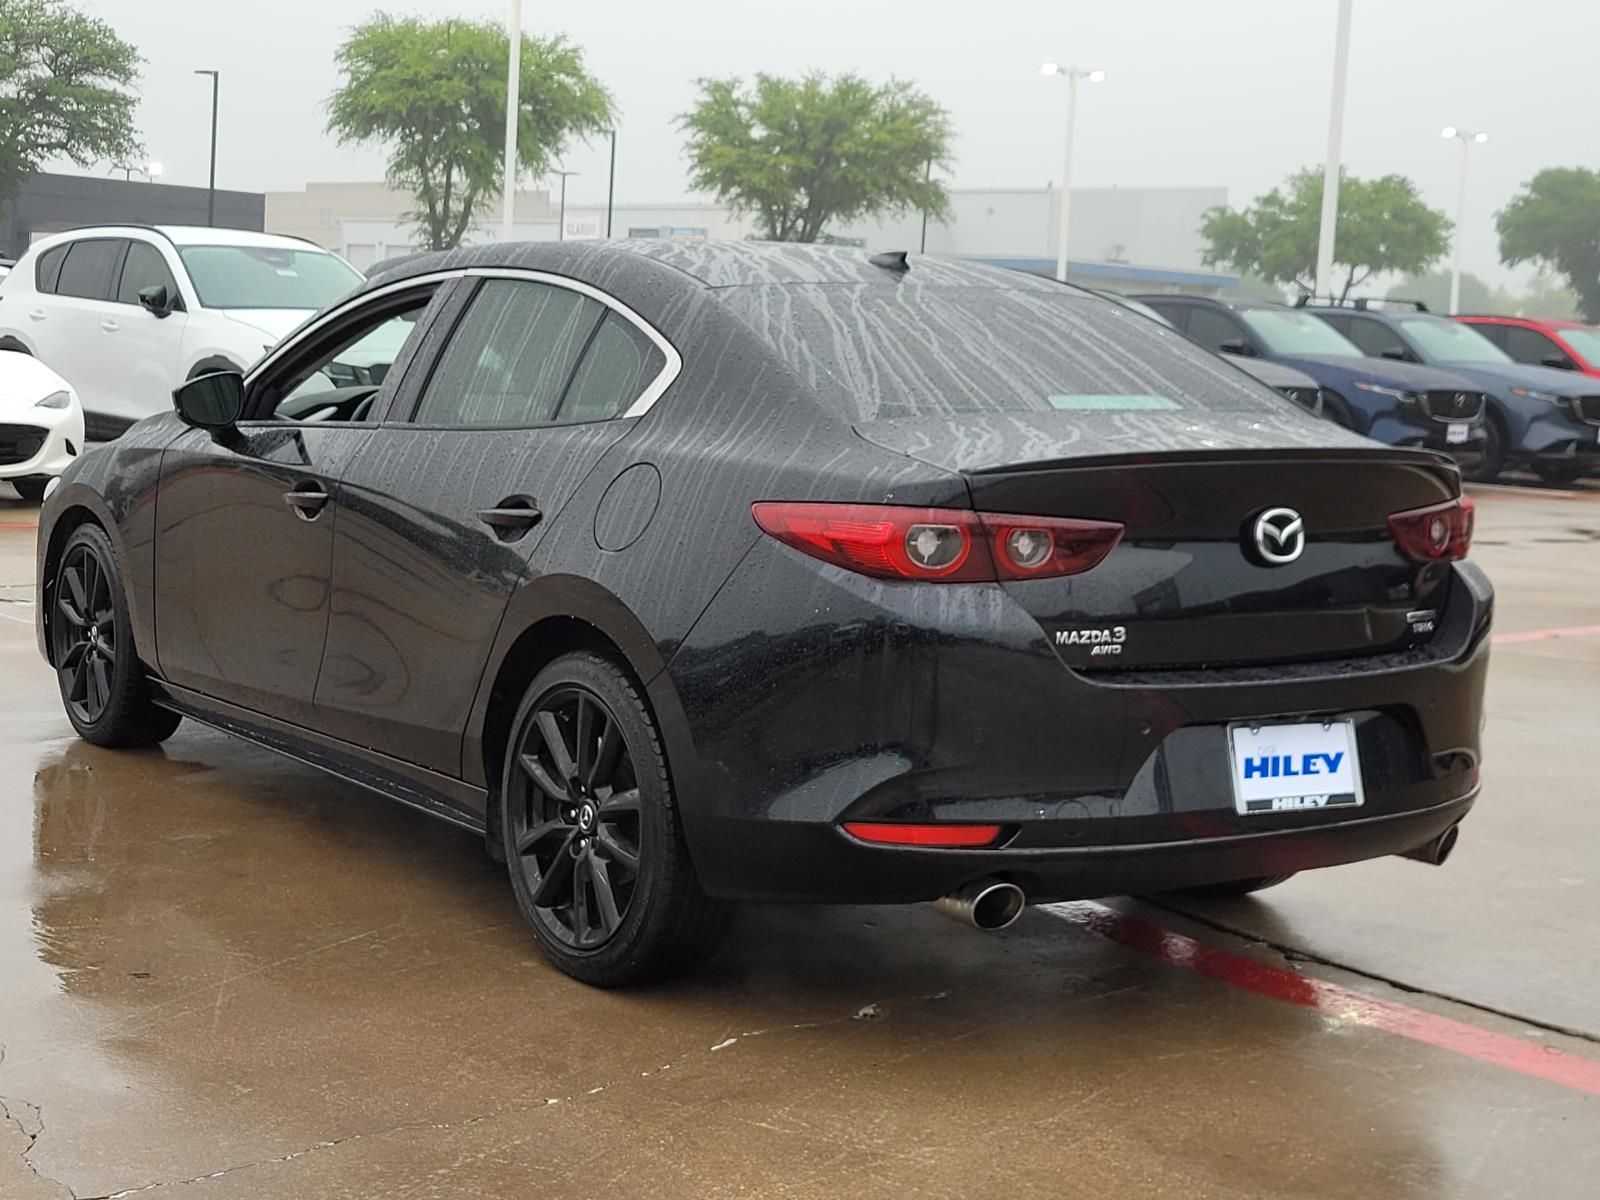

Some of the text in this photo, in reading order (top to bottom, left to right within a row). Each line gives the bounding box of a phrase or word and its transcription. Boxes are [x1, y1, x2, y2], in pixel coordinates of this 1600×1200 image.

[1091, 644, 1122, 656] AWD
[1244, 752, 1344, 779] HILEY
[1272, 795, 1329, 809] HILEY
